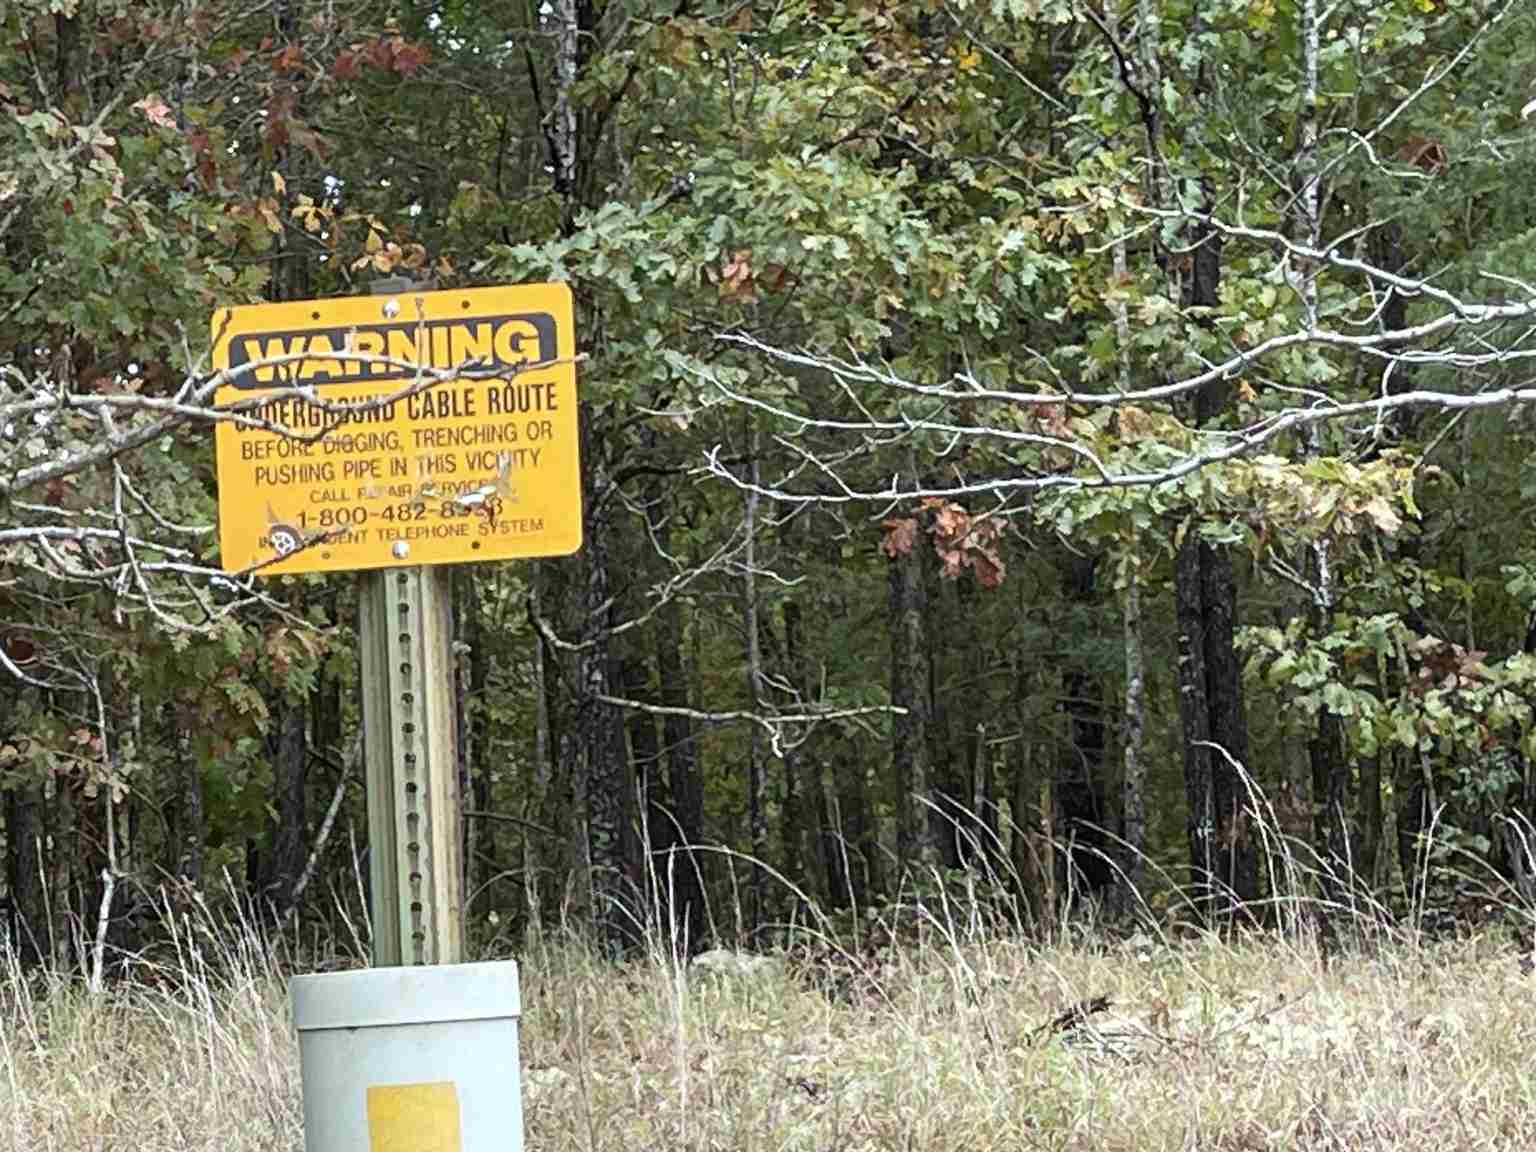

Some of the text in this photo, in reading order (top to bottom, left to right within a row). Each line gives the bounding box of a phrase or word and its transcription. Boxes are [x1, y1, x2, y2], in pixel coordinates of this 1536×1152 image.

[243, 319, 541, 382] WARNING
[407, 387, 476, 421] CABLE
[488, 383, 559, 415] ROUTE
[241, 436, 313, 460] BEFORE
[414, 422, 518, 449] TRENCHING
[526, 420, 554, 441] OR
[255, 461, 336, 486] PUSHING
[343, 459, 382, 480] PIPE
[390, 456, 408, 477] IN
[415, 452, 457, 475] THIS
[309, 487, 350, 504] CALL
[376, 523, 470, 541] TELEPHONE
[478, 518, 544, 537] SYSTEM
